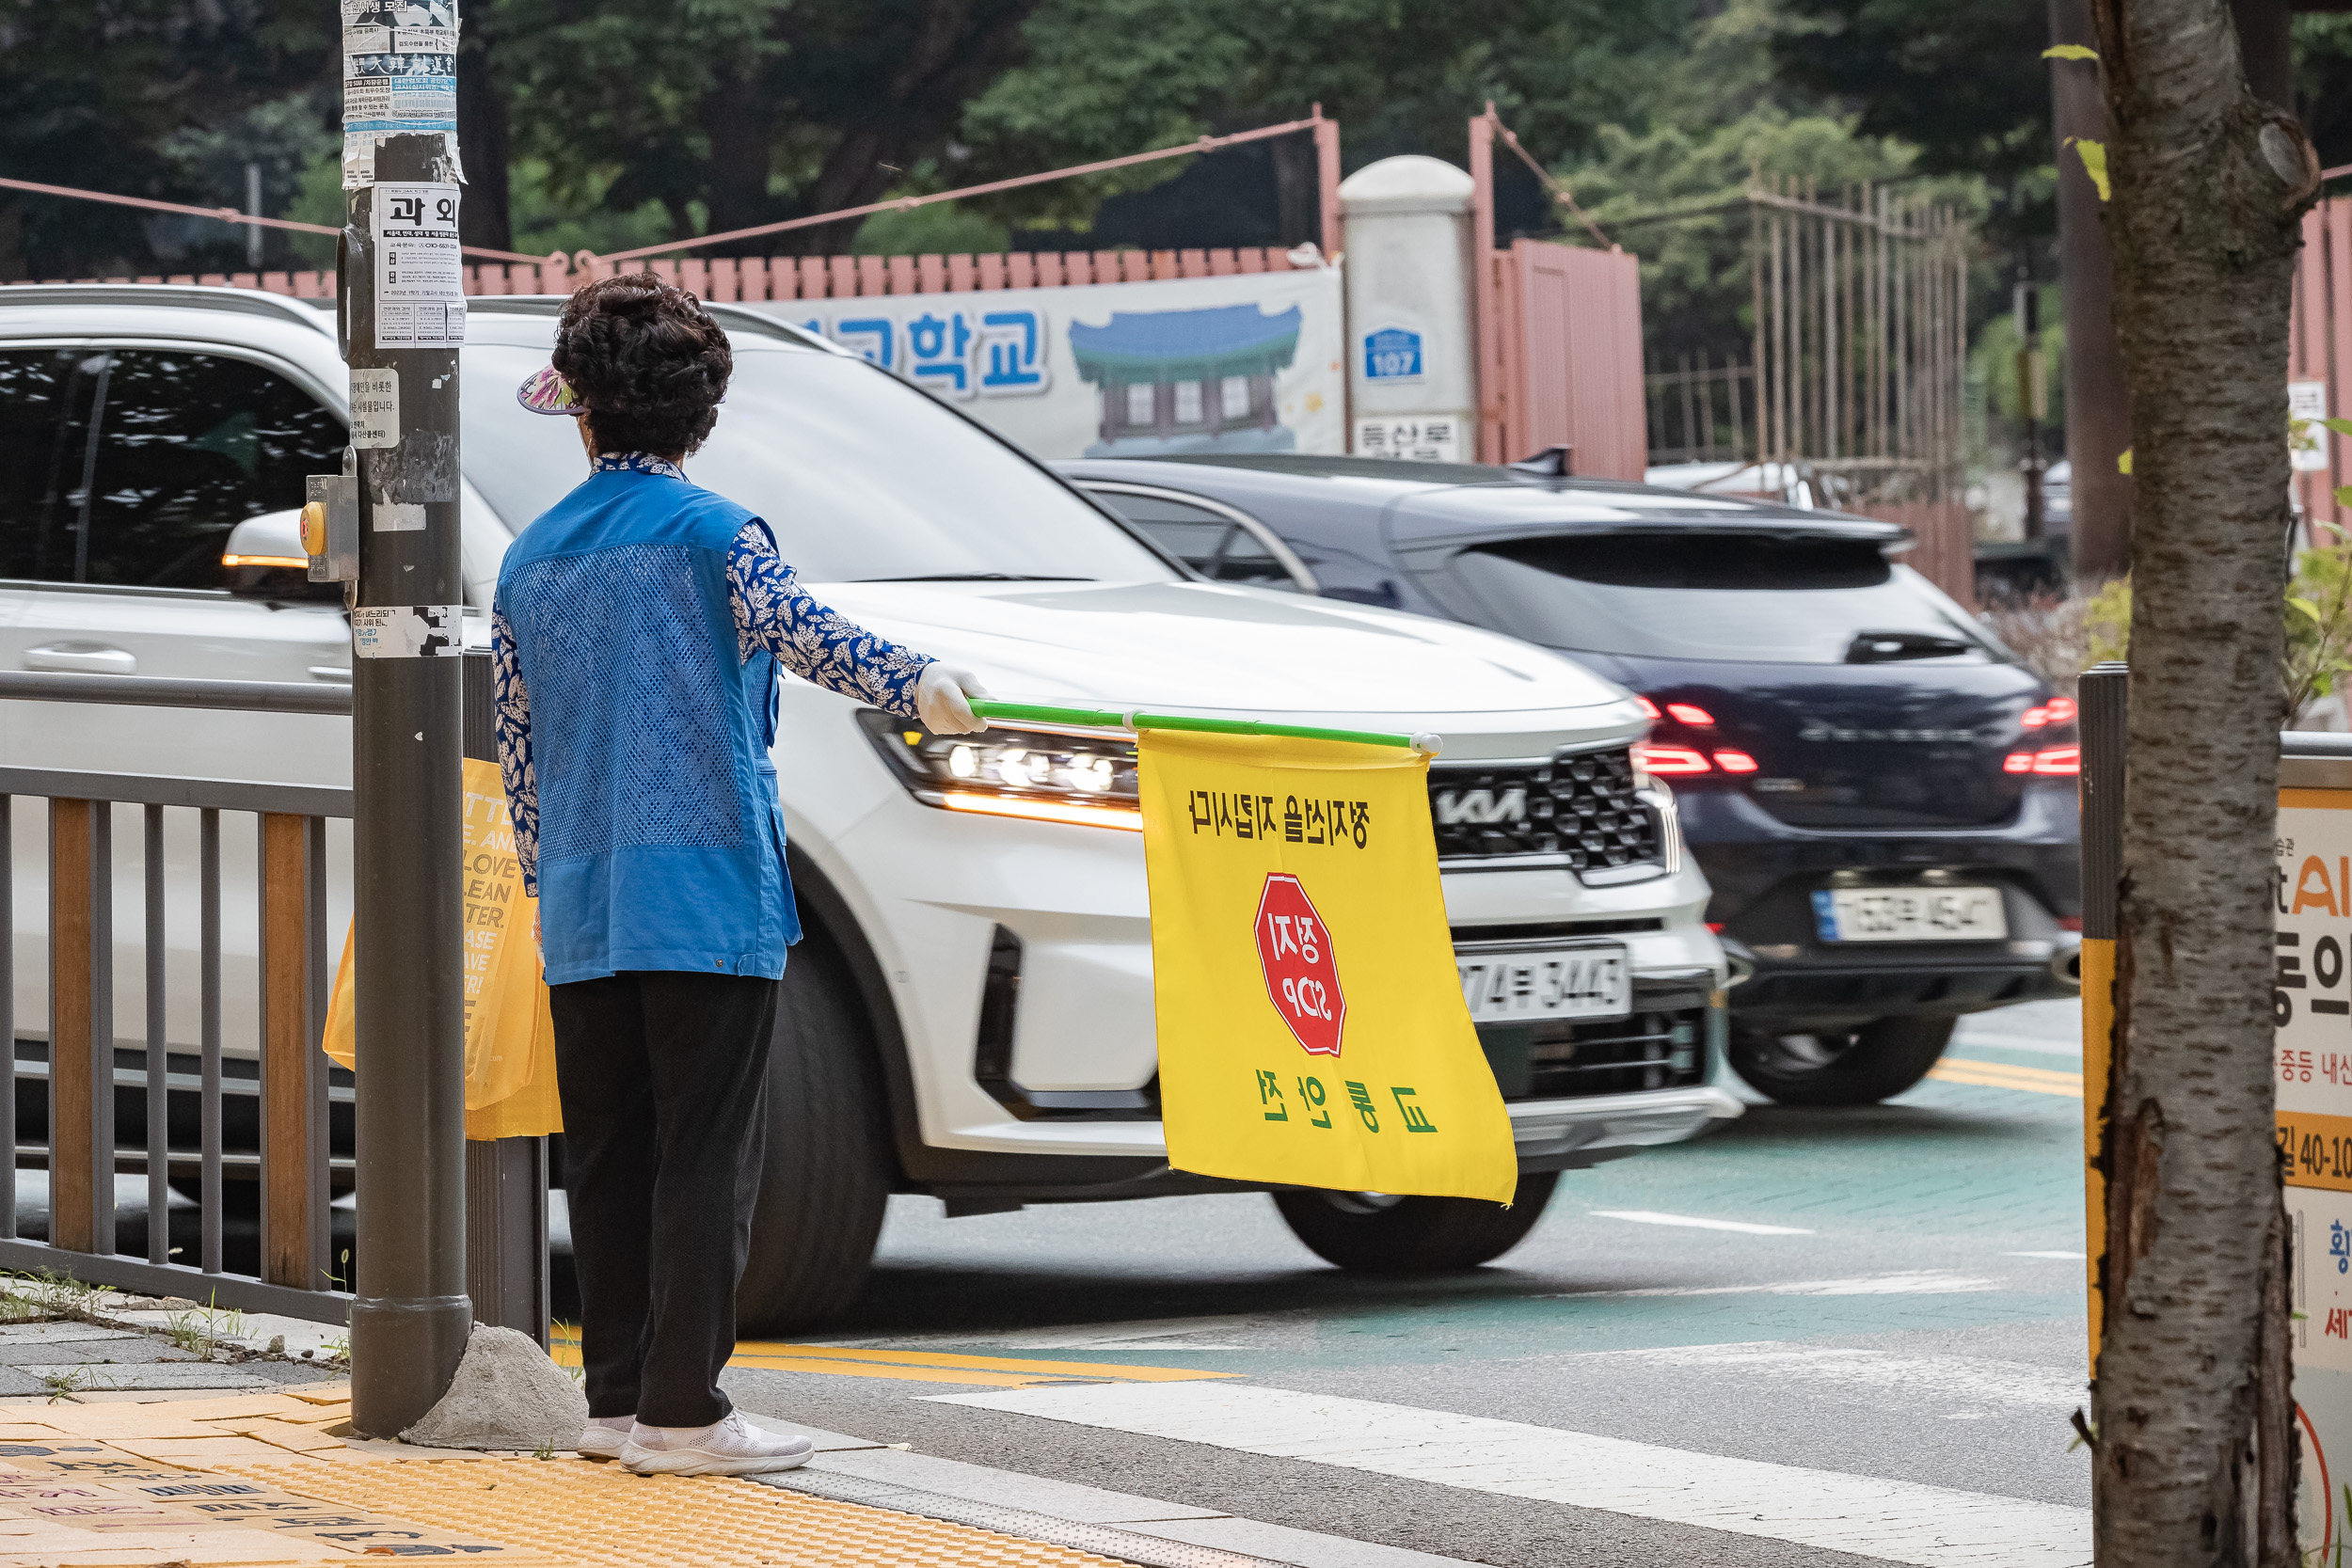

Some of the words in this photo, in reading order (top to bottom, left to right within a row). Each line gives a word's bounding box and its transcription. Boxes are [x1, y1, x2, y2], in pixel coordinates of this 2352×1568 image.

[384, 0, 407, 12] 모집
[373, 381, 391, 393] 비롯한
[463, 879, 512, 904] EAN
[466, 903, 504, 928] TER.
[465, 928, 498, 950] ASE
[2328, 1218, 2352, 1275] 횡
[2325, 1307, 2352, 1339] 세
